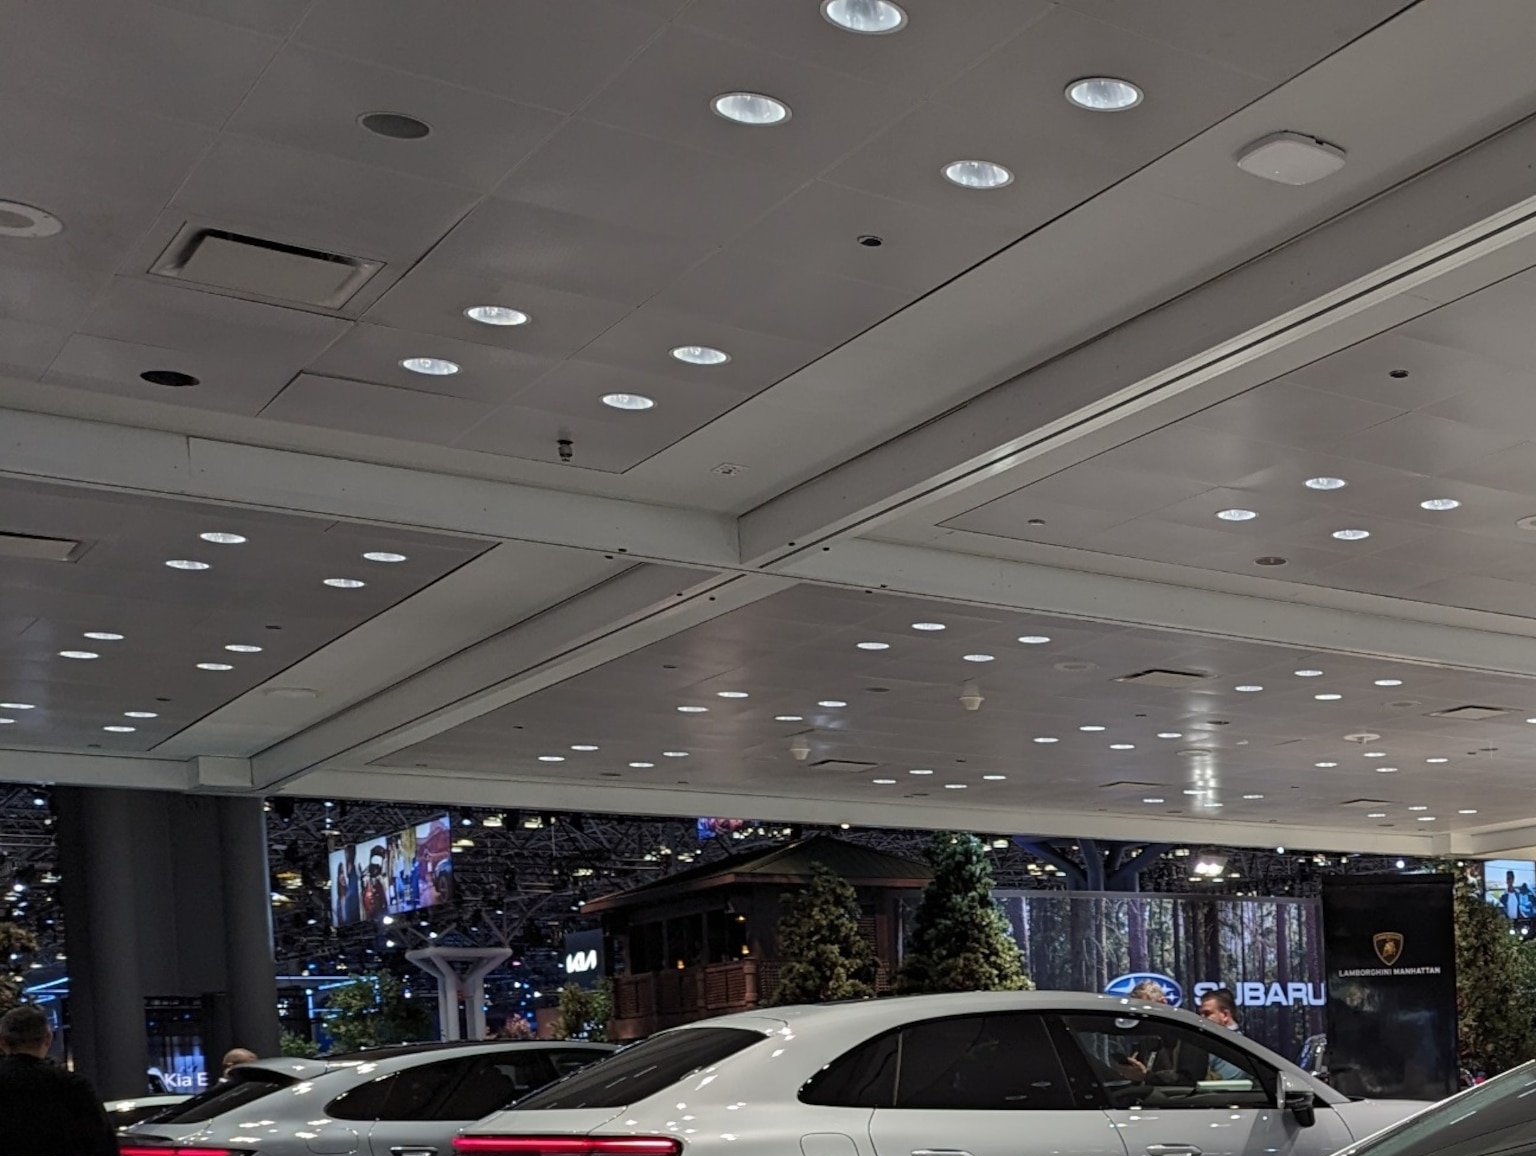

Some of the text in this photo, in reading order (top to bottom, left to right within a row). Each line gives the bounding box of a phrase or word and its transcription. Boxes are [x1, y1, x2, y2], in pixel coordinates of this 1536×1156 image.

[1338, 966, 1441, 978] LAMBORGHINI MANHATTAN
[164, 1073, 193, 1088] Kia
